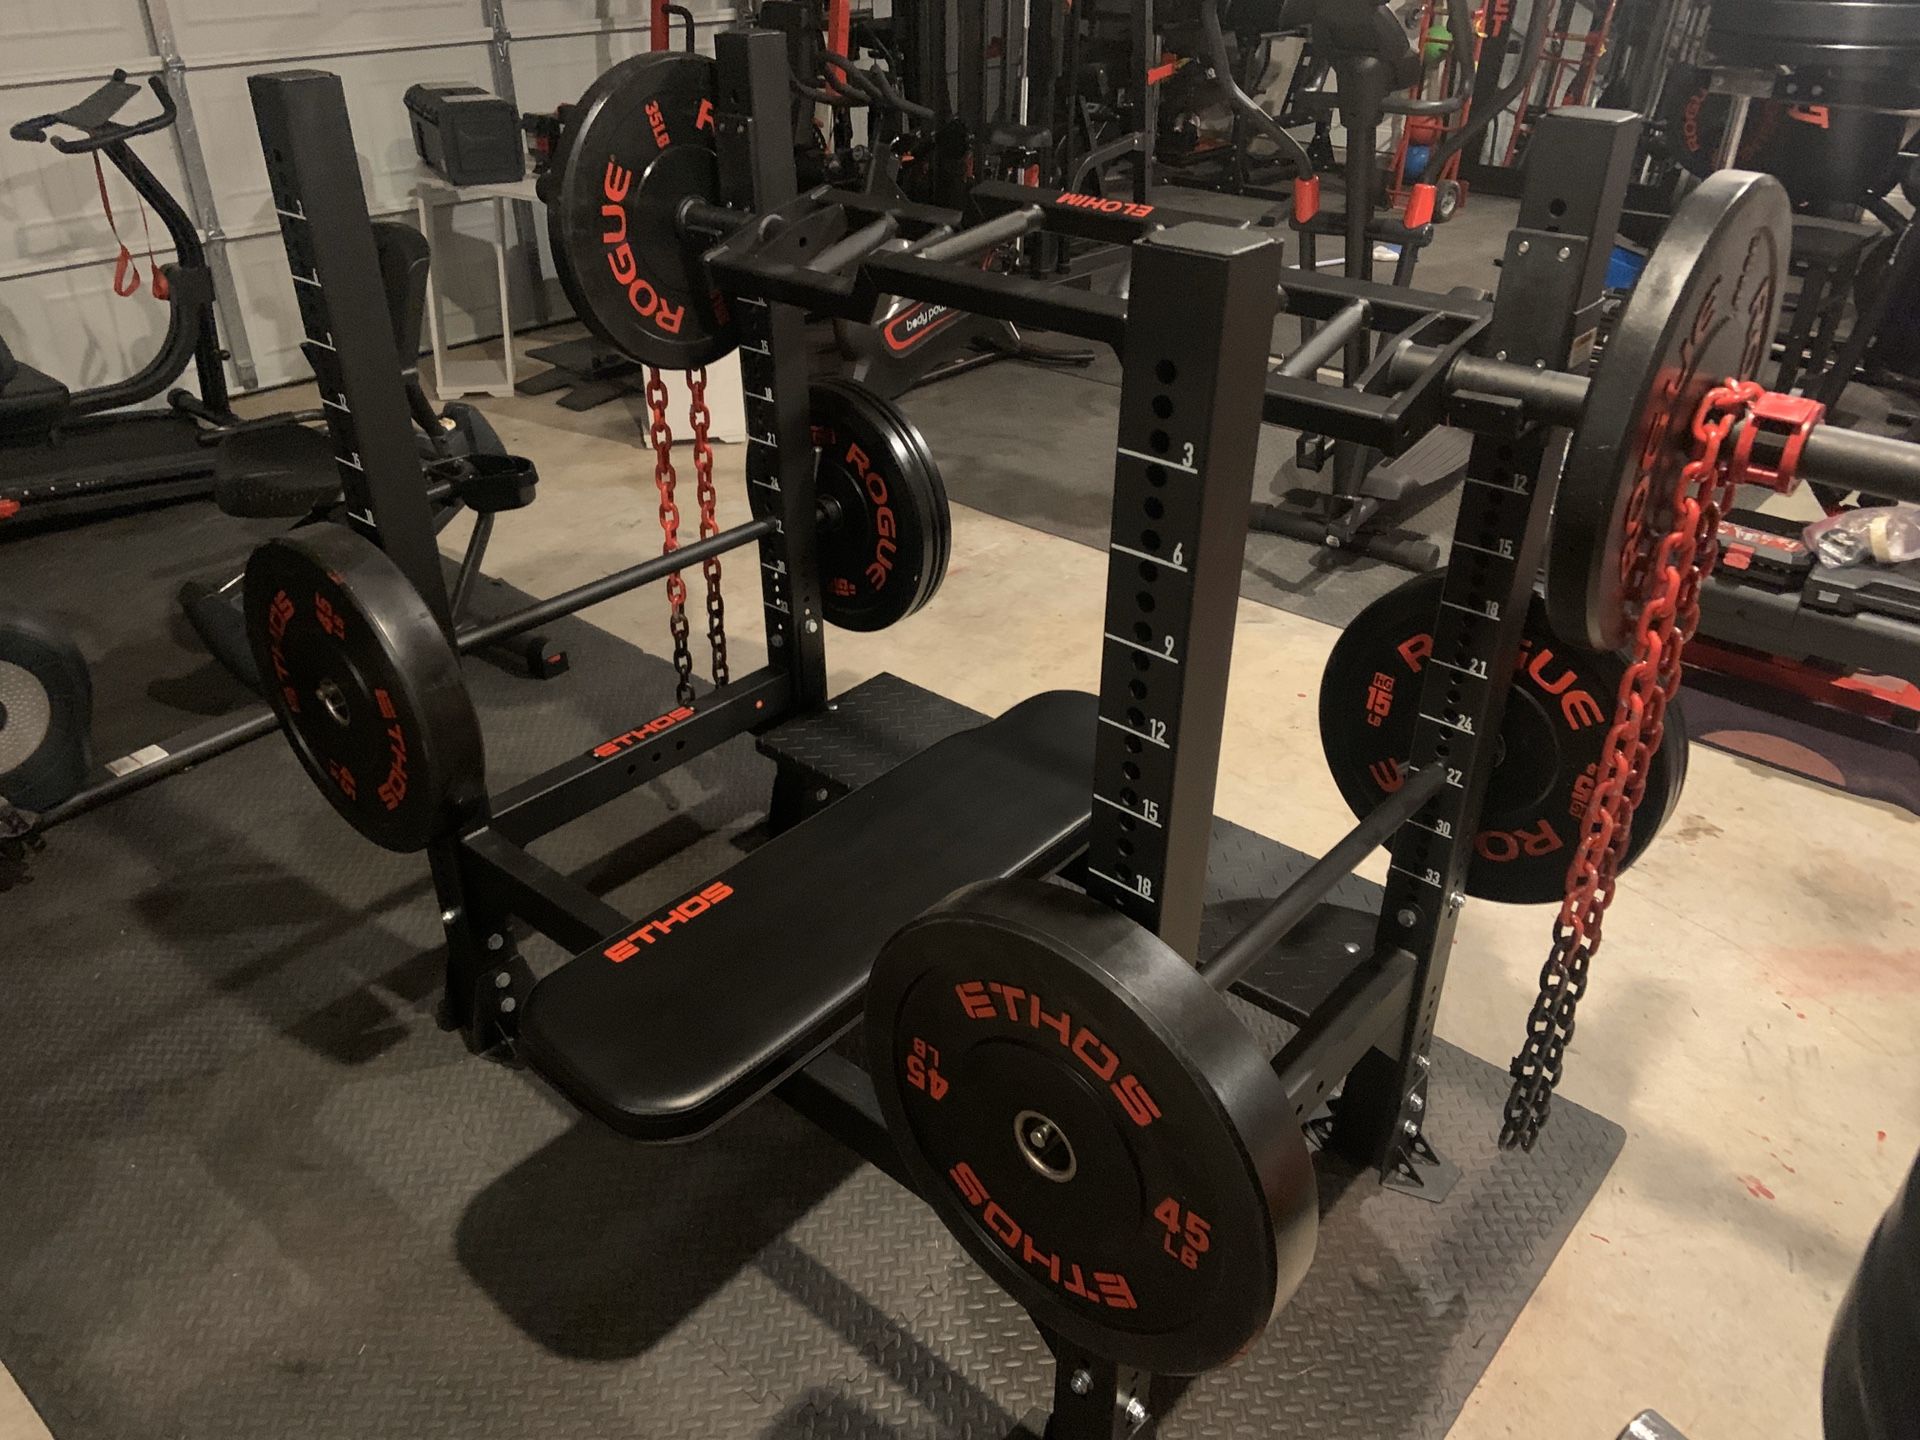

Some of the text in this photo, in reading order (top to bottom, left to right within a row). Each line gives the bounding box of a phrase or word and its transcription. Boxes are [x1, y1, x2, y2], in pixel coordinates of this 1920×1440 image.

[645, 100, 671, 149] 35LB
[1056, 193, 1154, 217] ELOHIM
[601, 162, 685, 333] ROGUE
[906, 311, 928, 331] body
[1182, 442, 1195, 467] 3
[1513, 473, 1529, 494] 12
[846, 441, 897, 591] ROGUE
[1172, 542, 1183, 565] 6
[1500, 538, 1514, 556] 15
[1485, 600, 1499, 618] 18
[1164, 635, 1175, 656] 9
[1468, 658, 1487, 678] 21
[1397, 633, 1605, 730] RUE
[1366, 686, 1393, 717] 15
[593, 706, 694, 757] ETHOS
[1149, 718, 1167, 743] 12
[1457, 714, 1473, 732] 24
[1446, 767, 1463, 784] 27
[1142, 798, 1159, 823] 15
[1435, 819, 1451, 836] 30
[1136, 874, 1152, 897] 18
[1425, 868, 1441, 885] 33
[603, 881, 734, 963] ETHOS
[913, 1037, 939, 1067] LB
[955, 981, 1162, 1126] ETHOS
[907, 1055, 949, 1100] 45
[950, 1162, 1137, 1309] ETHOS
[1154, 1197, 1211, 1252] 45
[1163, 1233, 1198, 1270] LB
